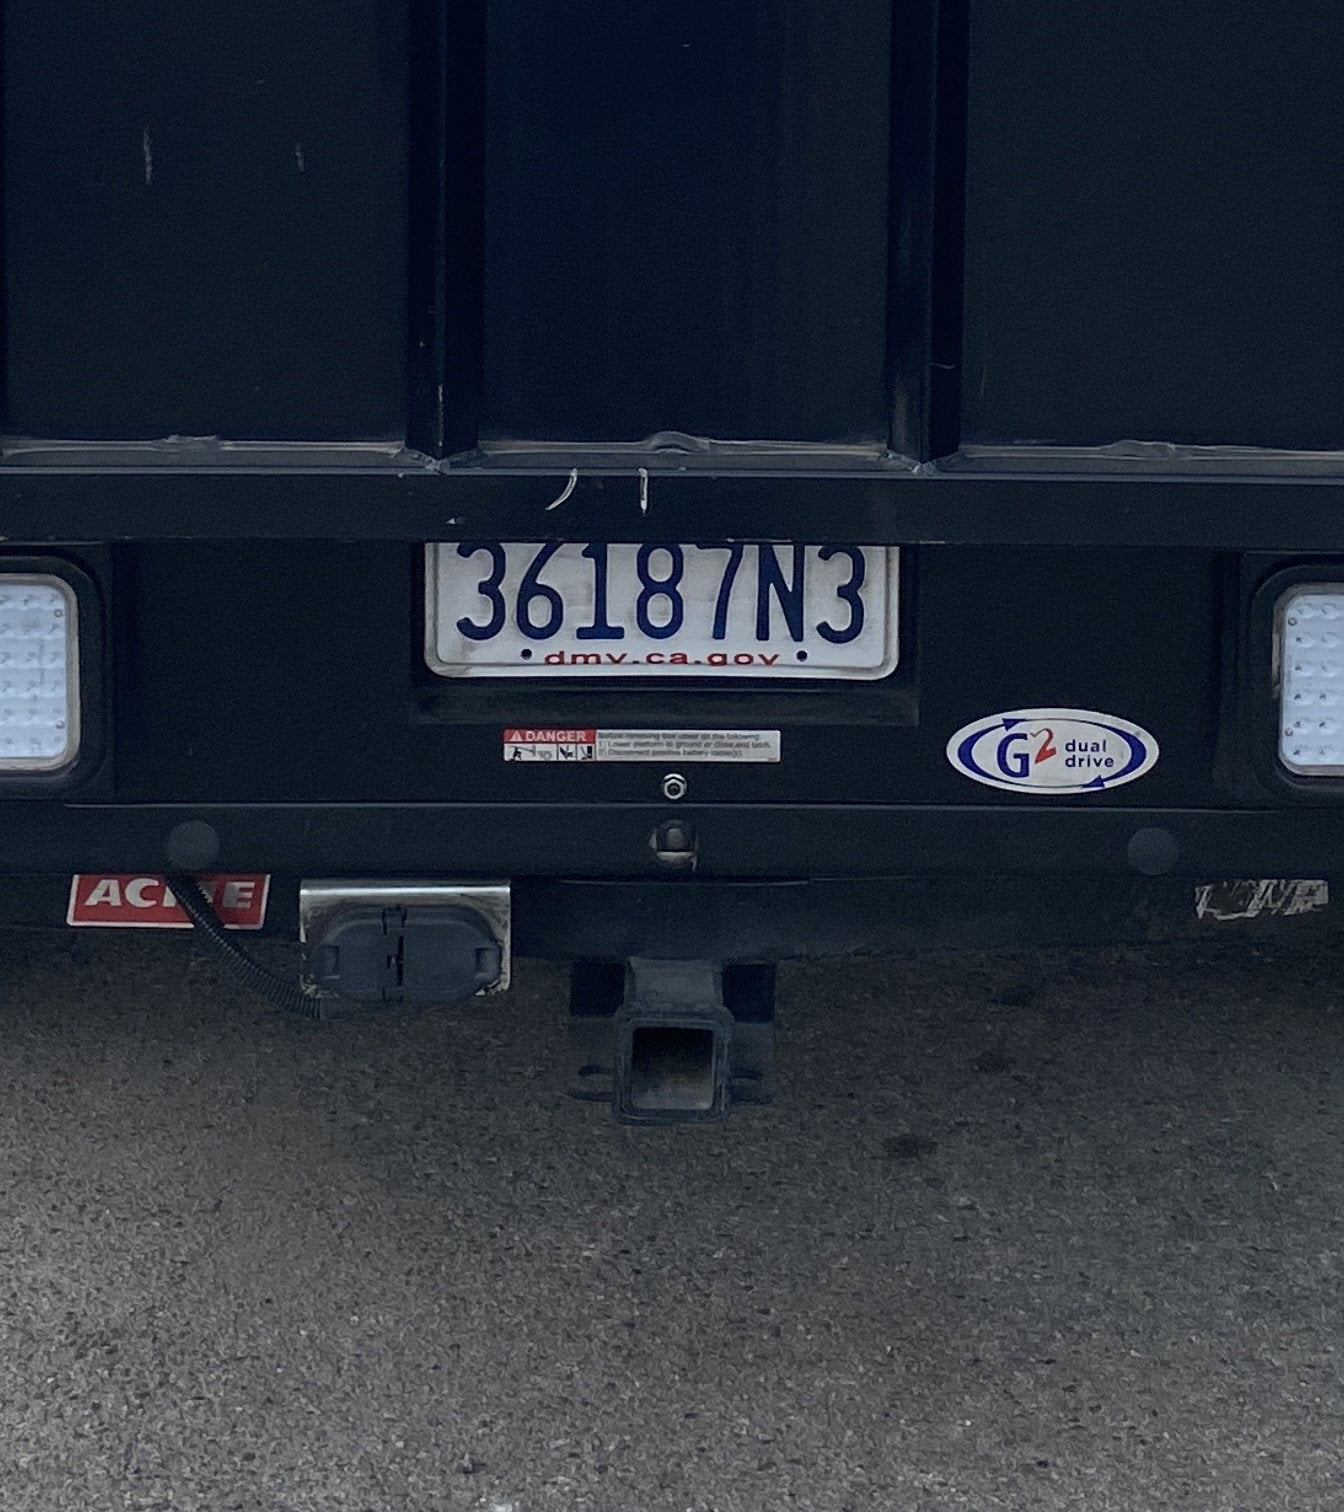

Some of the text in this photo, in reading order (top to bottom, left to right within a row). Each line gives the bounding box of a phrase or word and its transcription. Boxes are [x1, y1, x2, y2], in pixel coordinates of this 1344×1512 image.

[455, 542, 866, 645] 36187N3
[544, 649, 781, 666] dmv.ca.gov
[525, 730, 588, 742] DANGER
[1065, 739, 1107, 753] dual
[1065, 754, 1115, 768] drive
